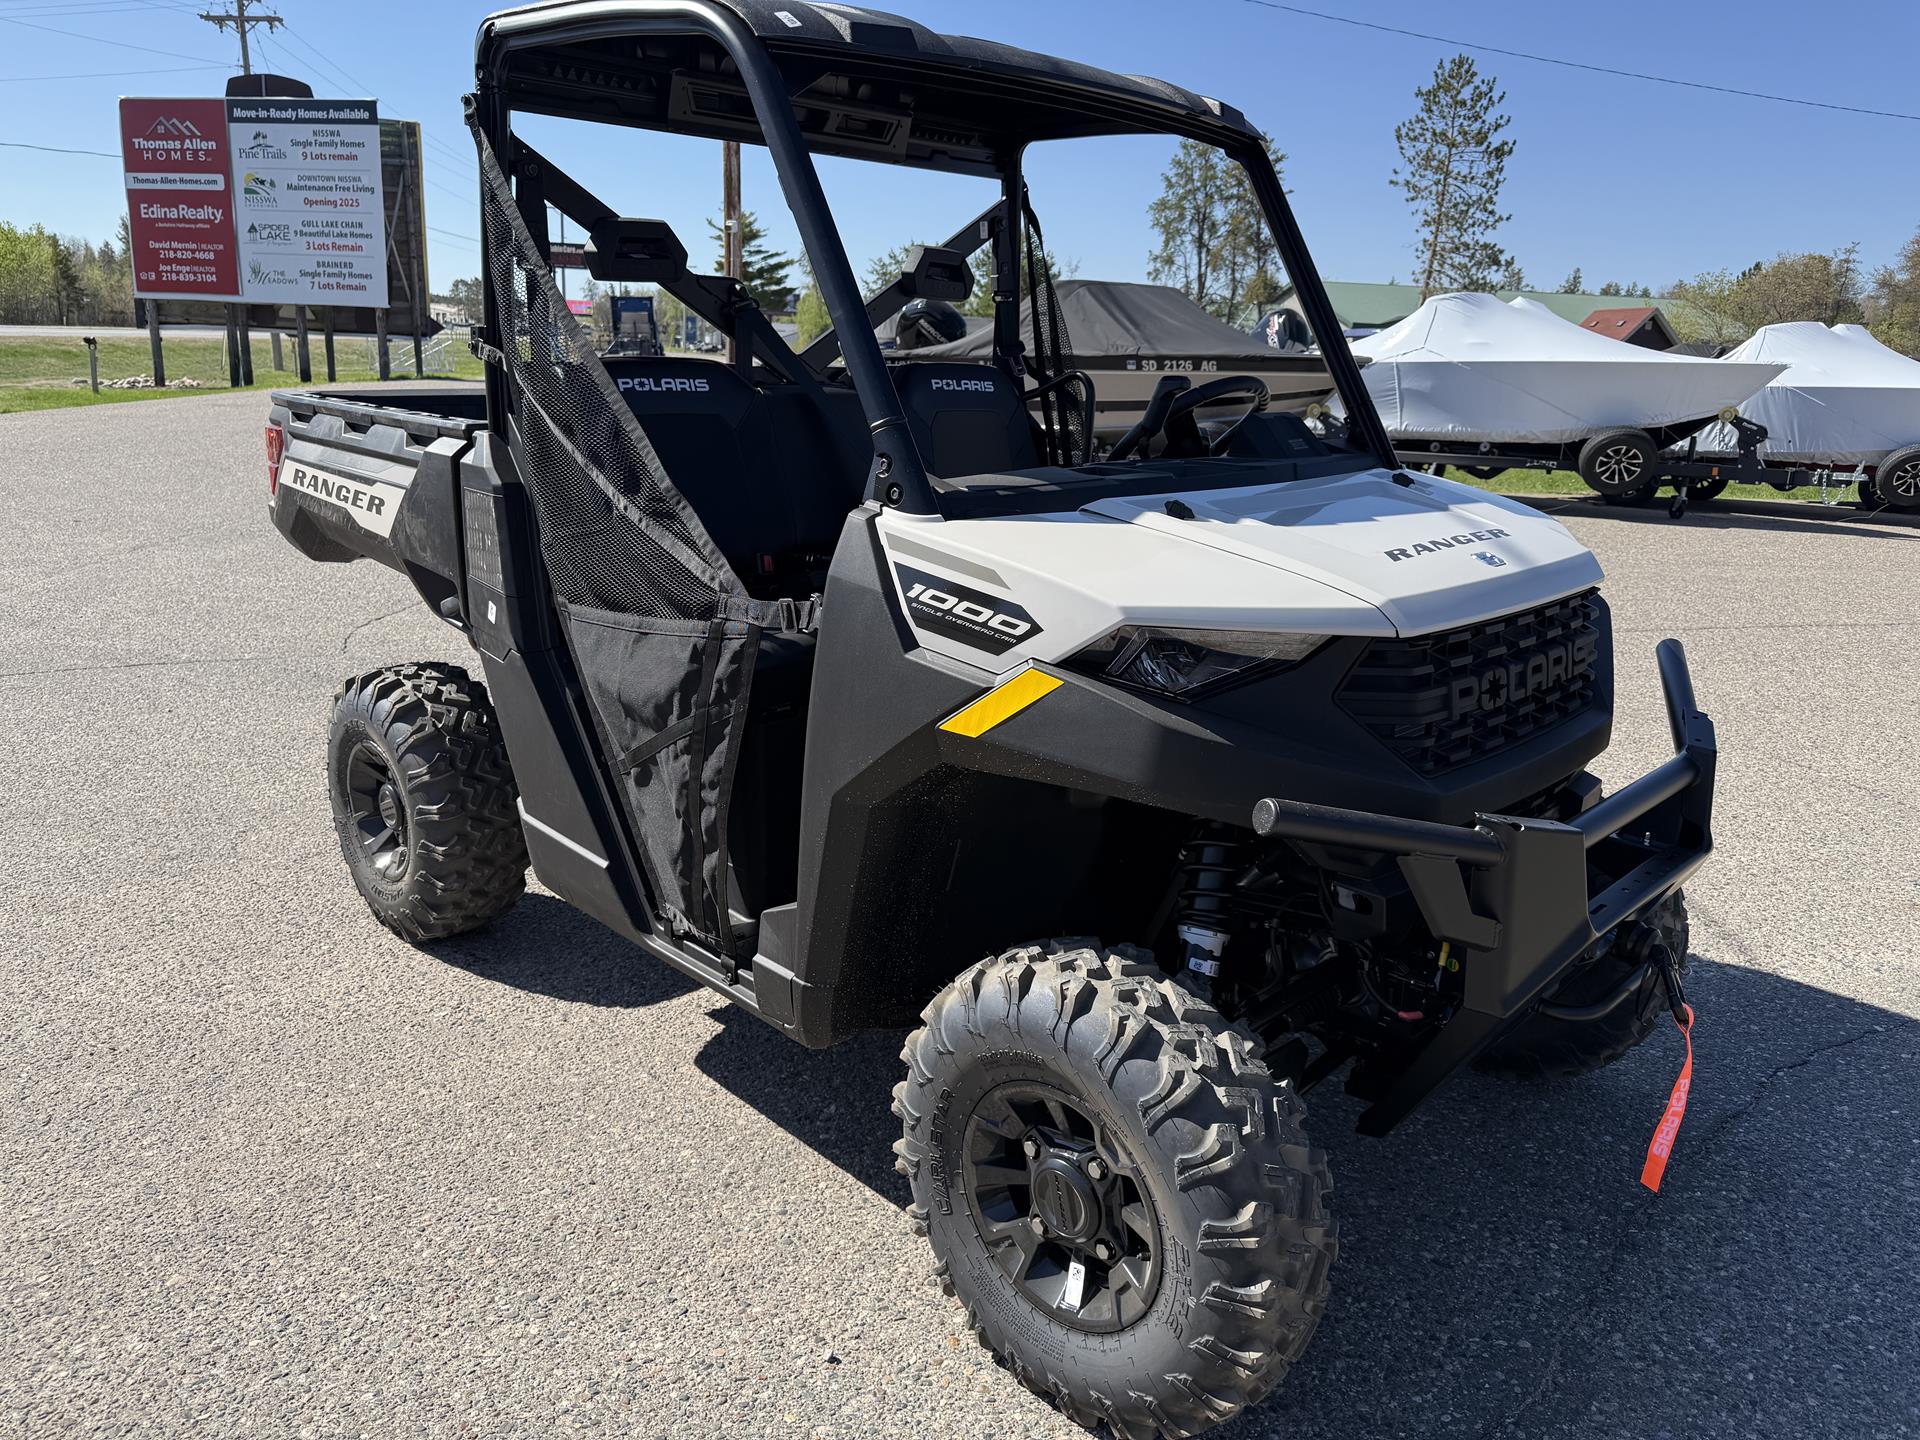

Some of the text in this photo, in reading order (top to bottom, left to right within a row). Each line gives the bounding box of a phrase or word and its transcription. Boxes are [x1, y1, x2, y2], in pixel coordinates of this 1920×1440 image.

[233, 107, 370, 121] Move-in-Ready Homes Available
[312, 129, 341, 138] NISSWA
[132, 138, 216, 150] Thomas Allen
[290, 139, 365, 150] Single Family Homes
[143, 151, 206, 161] HOMES
[238, 147, 287, 160] Pine Trails
[302, 151, 358, 161] 9 Lots remain
[297, 174, 363, 183] DOWNTOWN NISSWA
[286, 183, 375, 195] Maintenance Free Living
[244, 195, 278, 205] NISSWA
[303, 196, 360, 208] Opening 2025
[301, 219, 363, 230] GULL LAKE CHAIN
[259, 231, 291, 241] LAKE
[293, 229, 373, 240] 9 Beautiful Lake Homes
[149, 241, 170, 249] David
[171, 241, 197, 249] Mernin
[305, 240, 312, 251] 3
[312, 240, 331, 252] Lots
[331, 241, 364, 253] Remain
[159, 250, 215, 260] 218-820-4668
[159, 264, 171, 272] Joe
[172, 264, 190, 273] Enge
[316, 260, 354, 270] BRAINERD
[161, 273, 217, 282] 218-839-3104
[299, 269, 373, 281] Single Family Homes
[310, 280, 367, 292] 7 Lots Remain
[1141, 360, 1217, 372] SD 2126 AG
[617, 378, 710, 392] POLARIS
[931, 379, 995, 392] POLARIS
[292, 468, 386, 516] RANGER
[1383, 527, 1511, 563] RANGER
[906, 583, 1031, 636] 1000
[911, 602, 1018, 644] SINGLE OVERHEAD CAM
[1448, 630, 1600, 721] POLARIS
[1653, 1079, 1689, 1158] POLARIS
[931, 1087, 953, 1216] CARLSTAR
